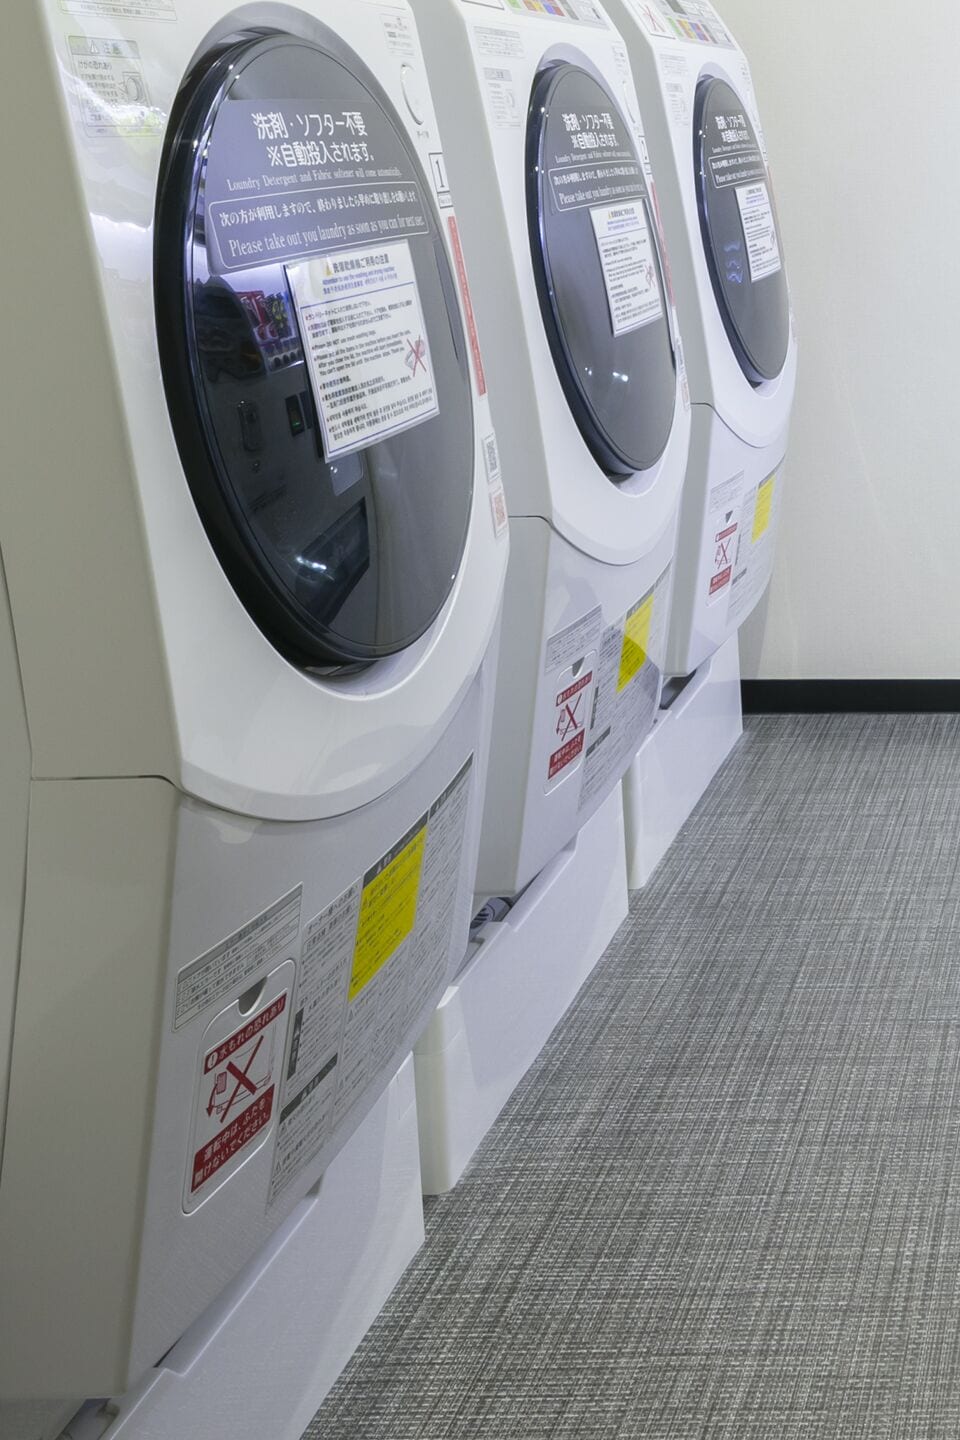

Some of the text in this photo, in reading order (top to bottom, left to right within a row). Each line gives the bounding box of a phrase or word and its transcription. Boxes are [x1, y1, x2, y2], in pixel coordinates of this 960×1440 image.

[251, 112, 368, 140] 洗剤・ソフター不要
[262, 173, 299, 188] Detergent
[299, 171, 312, 182] and
[312, 170, 332, 181] Fabric
[228, 237, 263, 257] Please
[264, 233, 287, 249] take
[287, 233, 302, 245] out
[319, 223, 347, 242] laundry
[218, 998, 285, 1057] 水もれの恐れあり
